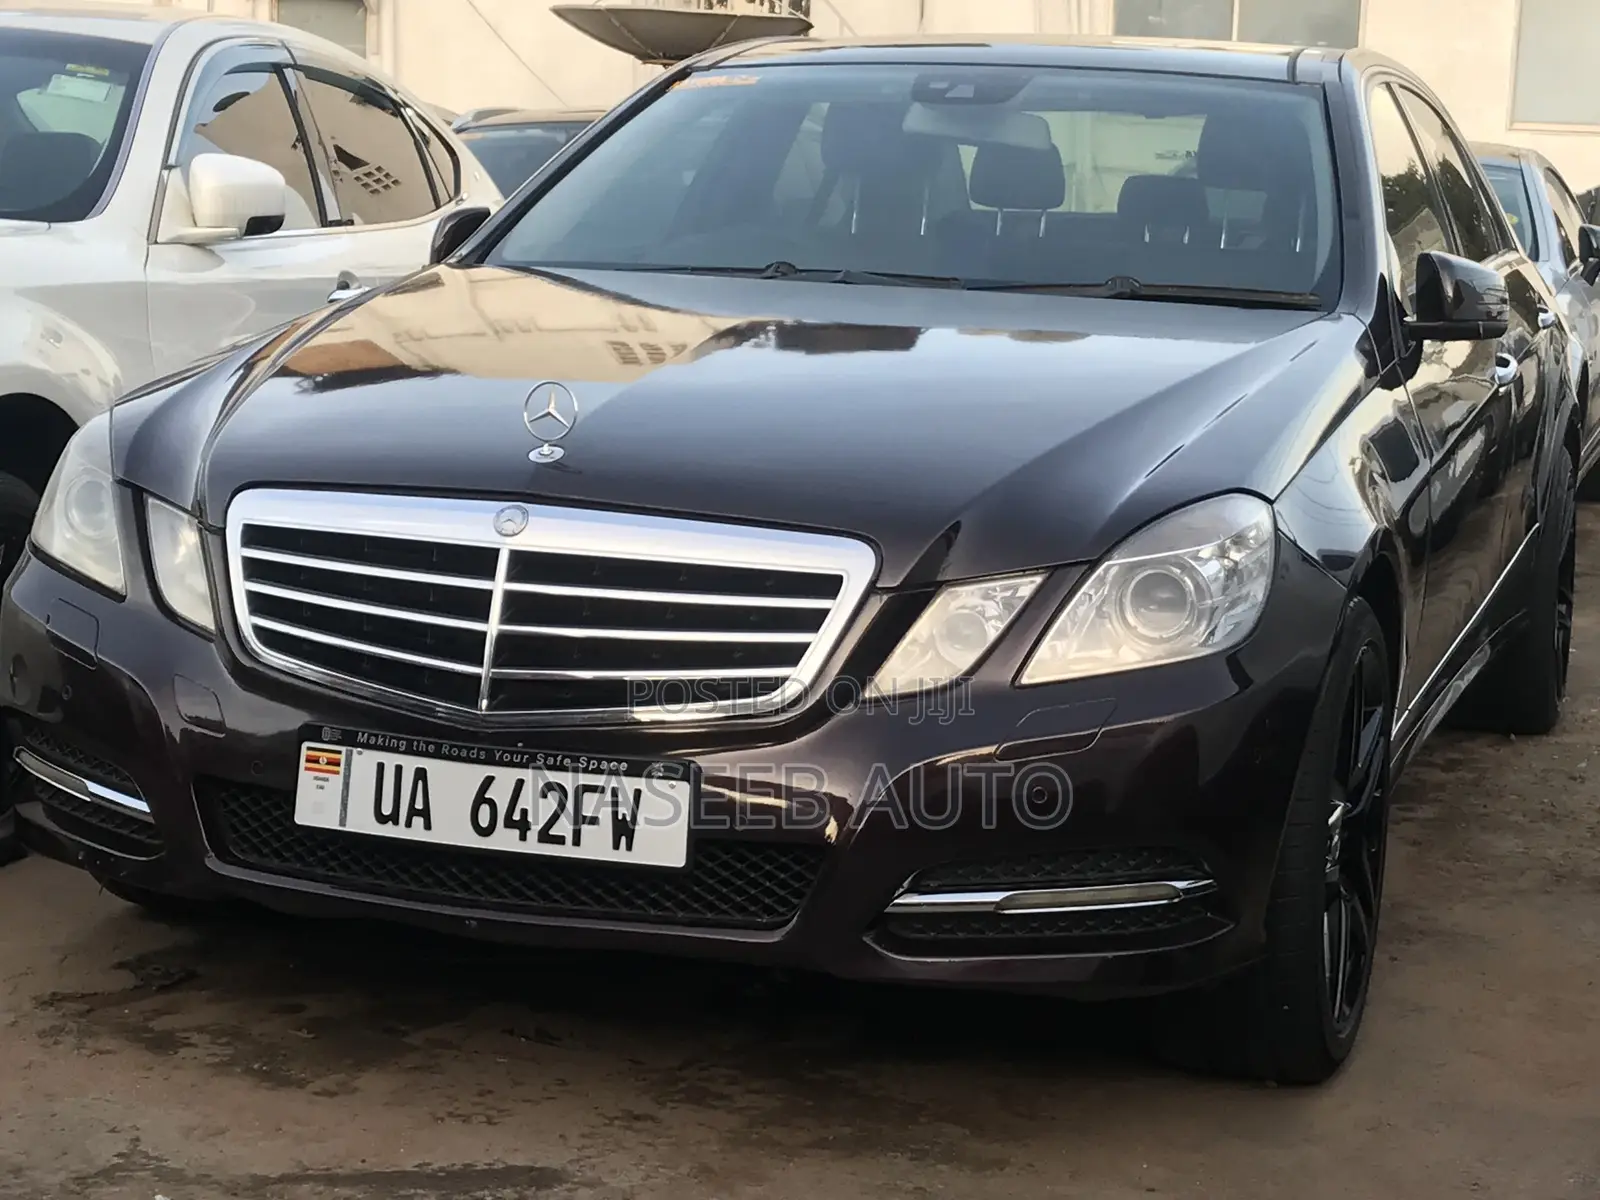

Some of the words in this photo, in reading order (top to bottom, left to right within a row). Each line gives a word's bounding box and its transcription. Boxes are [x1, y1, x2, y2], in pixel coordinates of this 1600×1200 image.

[357, 732, 407, 751] Making
[412, 741, 436, 753] the
[441, 744, 486, 759] Roads
[494, 749, 529, 763] Your
[536, 753, 572, 767] Safe
[579, 756, 628, 771] Space
[373, 761, 432, 831] UA
[470, 775, 642, 852] 642FW
